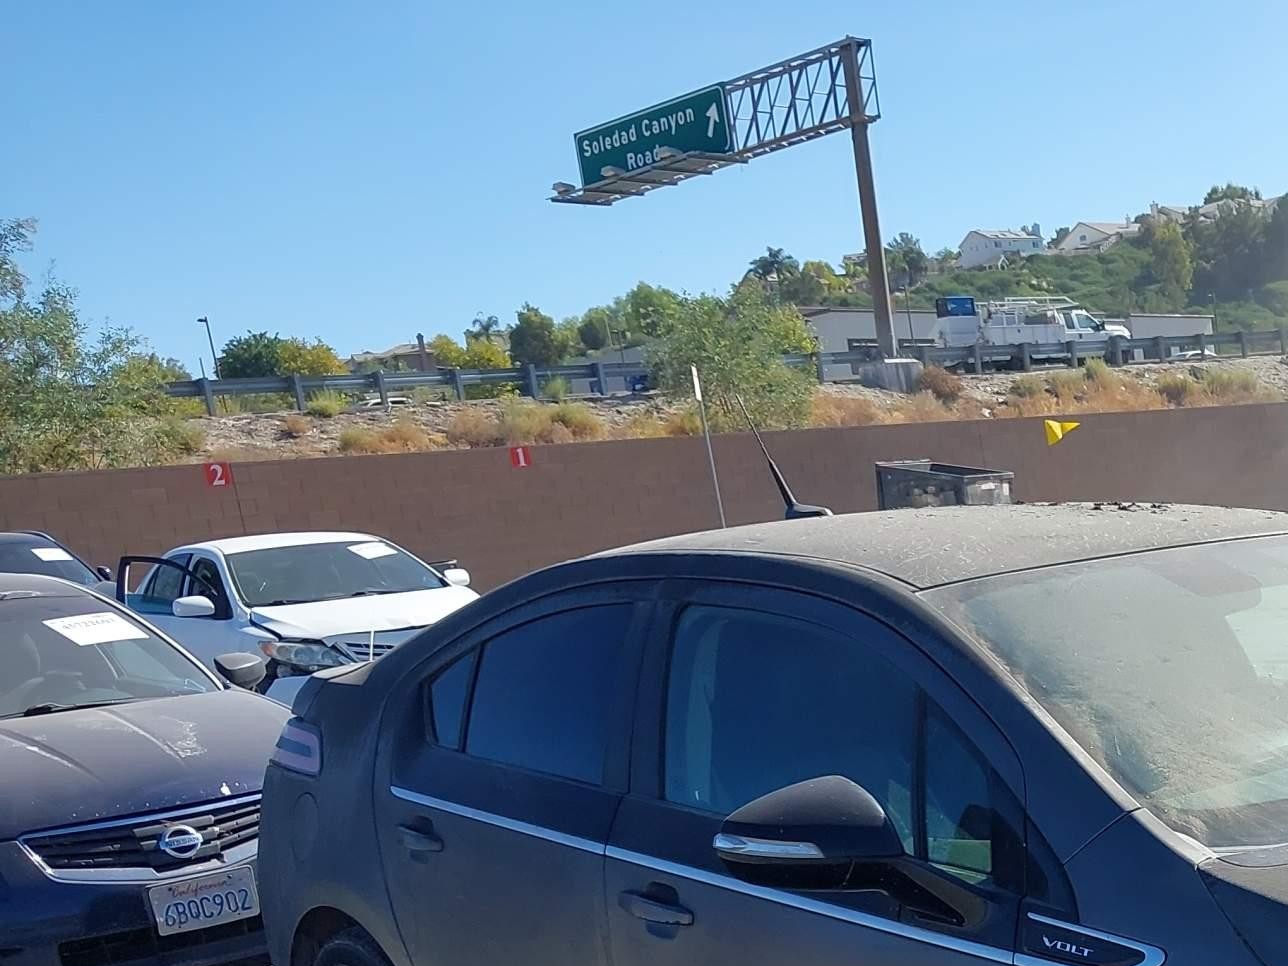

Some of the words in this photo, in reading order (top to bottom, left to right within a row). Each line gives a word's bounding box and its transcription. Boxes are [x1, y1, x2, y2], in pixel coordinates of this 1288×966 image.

[582, 125, 637, 157] Soledad
[641, 107, 695, 136] Canyon
[626, 144, 661, 170] Road
[516, 447, 528, 467] 1
[210, 464, 226, 486] 2
[172, 880, 232, 898] California
[164, 888, 252, 927] 6BQC902
[1042, 934, 1095, 957] VOLT
